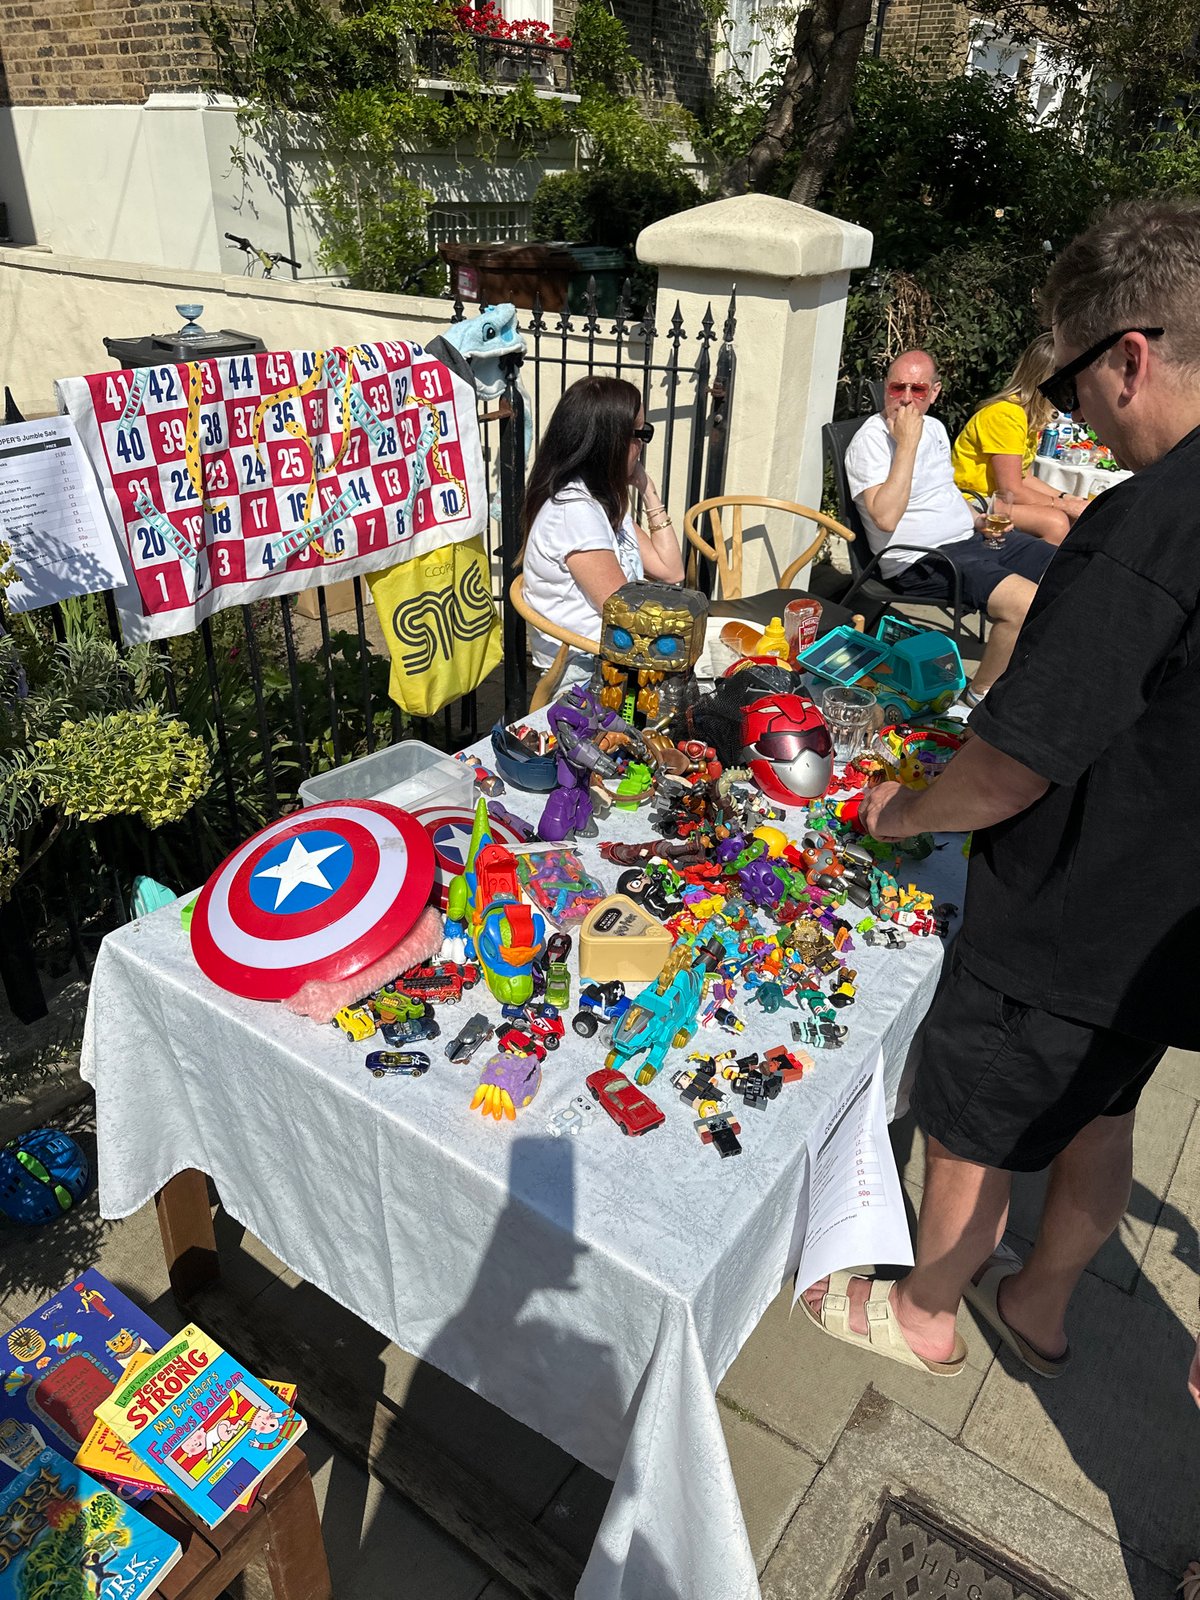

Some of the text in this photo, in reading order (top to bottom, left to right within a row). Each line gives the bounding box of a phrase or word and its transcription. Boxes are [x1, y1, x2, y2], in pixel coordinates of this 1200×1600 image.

[105, 374, 131, 411] 41
[150, 367, 178, 403] 42
[199, 362, 216, 395] 3
[228, 357, 253, 390] 44
[265, 354, 291, 386] 45
[358, 343, 379, 371] 48
[385, 341, 406, 364] 49
[116, 427, 146, 463] 40
[159, 419, 186, 454] 39
[201, 412, 222, 446] 38
[234, 407, 256, 439] 37
[271, 401, 296, 433] 36
[310, 398, 324, 429] 35
[370, 384, 390, 416] 33
[395, 376, 407, 407] 32
[420, 369, 443, 398] 31
[22, 432, 44, 441] Jumble
[128, 477, 150, 505] 21
[171, 468, 198, 502] 22
[205, 460, 229, 491] 23
[242, 454, 266, 485] 24
[277, 448, 305, 479] 25
[314, 443, 326, 473] 26
[342, 435, 361, 466] 27
[377, 427, 397, 457] 28
[401, 418, 416, 448] 29
[137, 525, 166, 560] 20
[182, 515, 203, 548] 19
[212, 506, 232, 534] 18
[250, 497, 268, 528] 17
[287, 492, 307, 522] 16
[348, 477, 371, 507] 14
[381, 468, 402, 498] 13
[155, 572, 170, 602] 1
[217, 549, 230, 576] 3
[262, 543, 275, 570] 4
[334, 528, 345, 553] 6
[366, 517, 376, 545] 7
[396, 509, 406, 534] 8
[418, 498, 425, 523] 9
[440, 489, 459, 514] 10
[126, 1349, 209, 1430] STRONG
[132, 1355, 186, 1405] Jeremy
[147, 1371, 244, 1465] Famous Bottom
[153, 1370, 219, 1436] My Brother's
[137, 1556, 161, 1583] MAN
